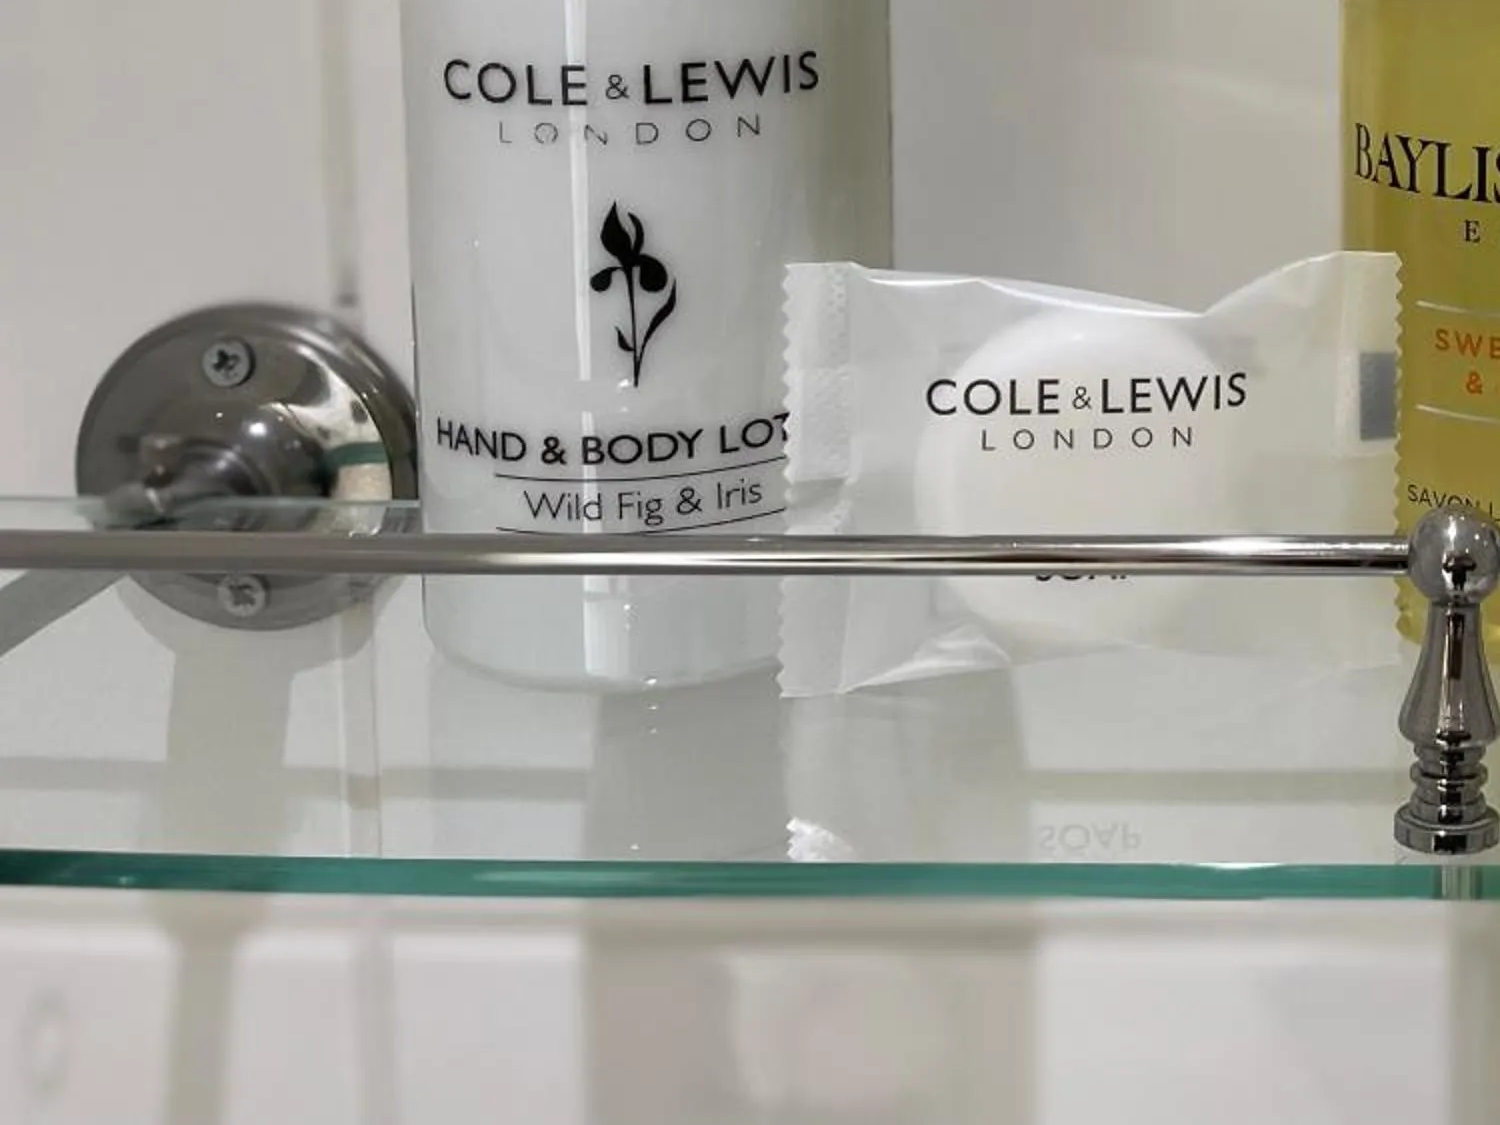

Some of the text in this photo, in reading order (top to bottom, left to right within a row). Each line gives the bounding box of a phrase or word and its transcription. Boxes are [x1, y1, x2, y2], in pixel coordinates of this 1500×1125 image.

[443, 51, 820, 106] COLE & LEWIS
[499, 115, 761, 146] LONDON
[926, 372, 1248, 416] COLE & LEWIS
[1465, 371, 1485, 395] &
[436, 416, 528, 462] HAND
[540, 435, 568, 466] &
[581, 428, 704, 466] BODY
[981, 426, 1194, 452] LONDON
[523, 478, 764, 527] Wild Fig & Iris
